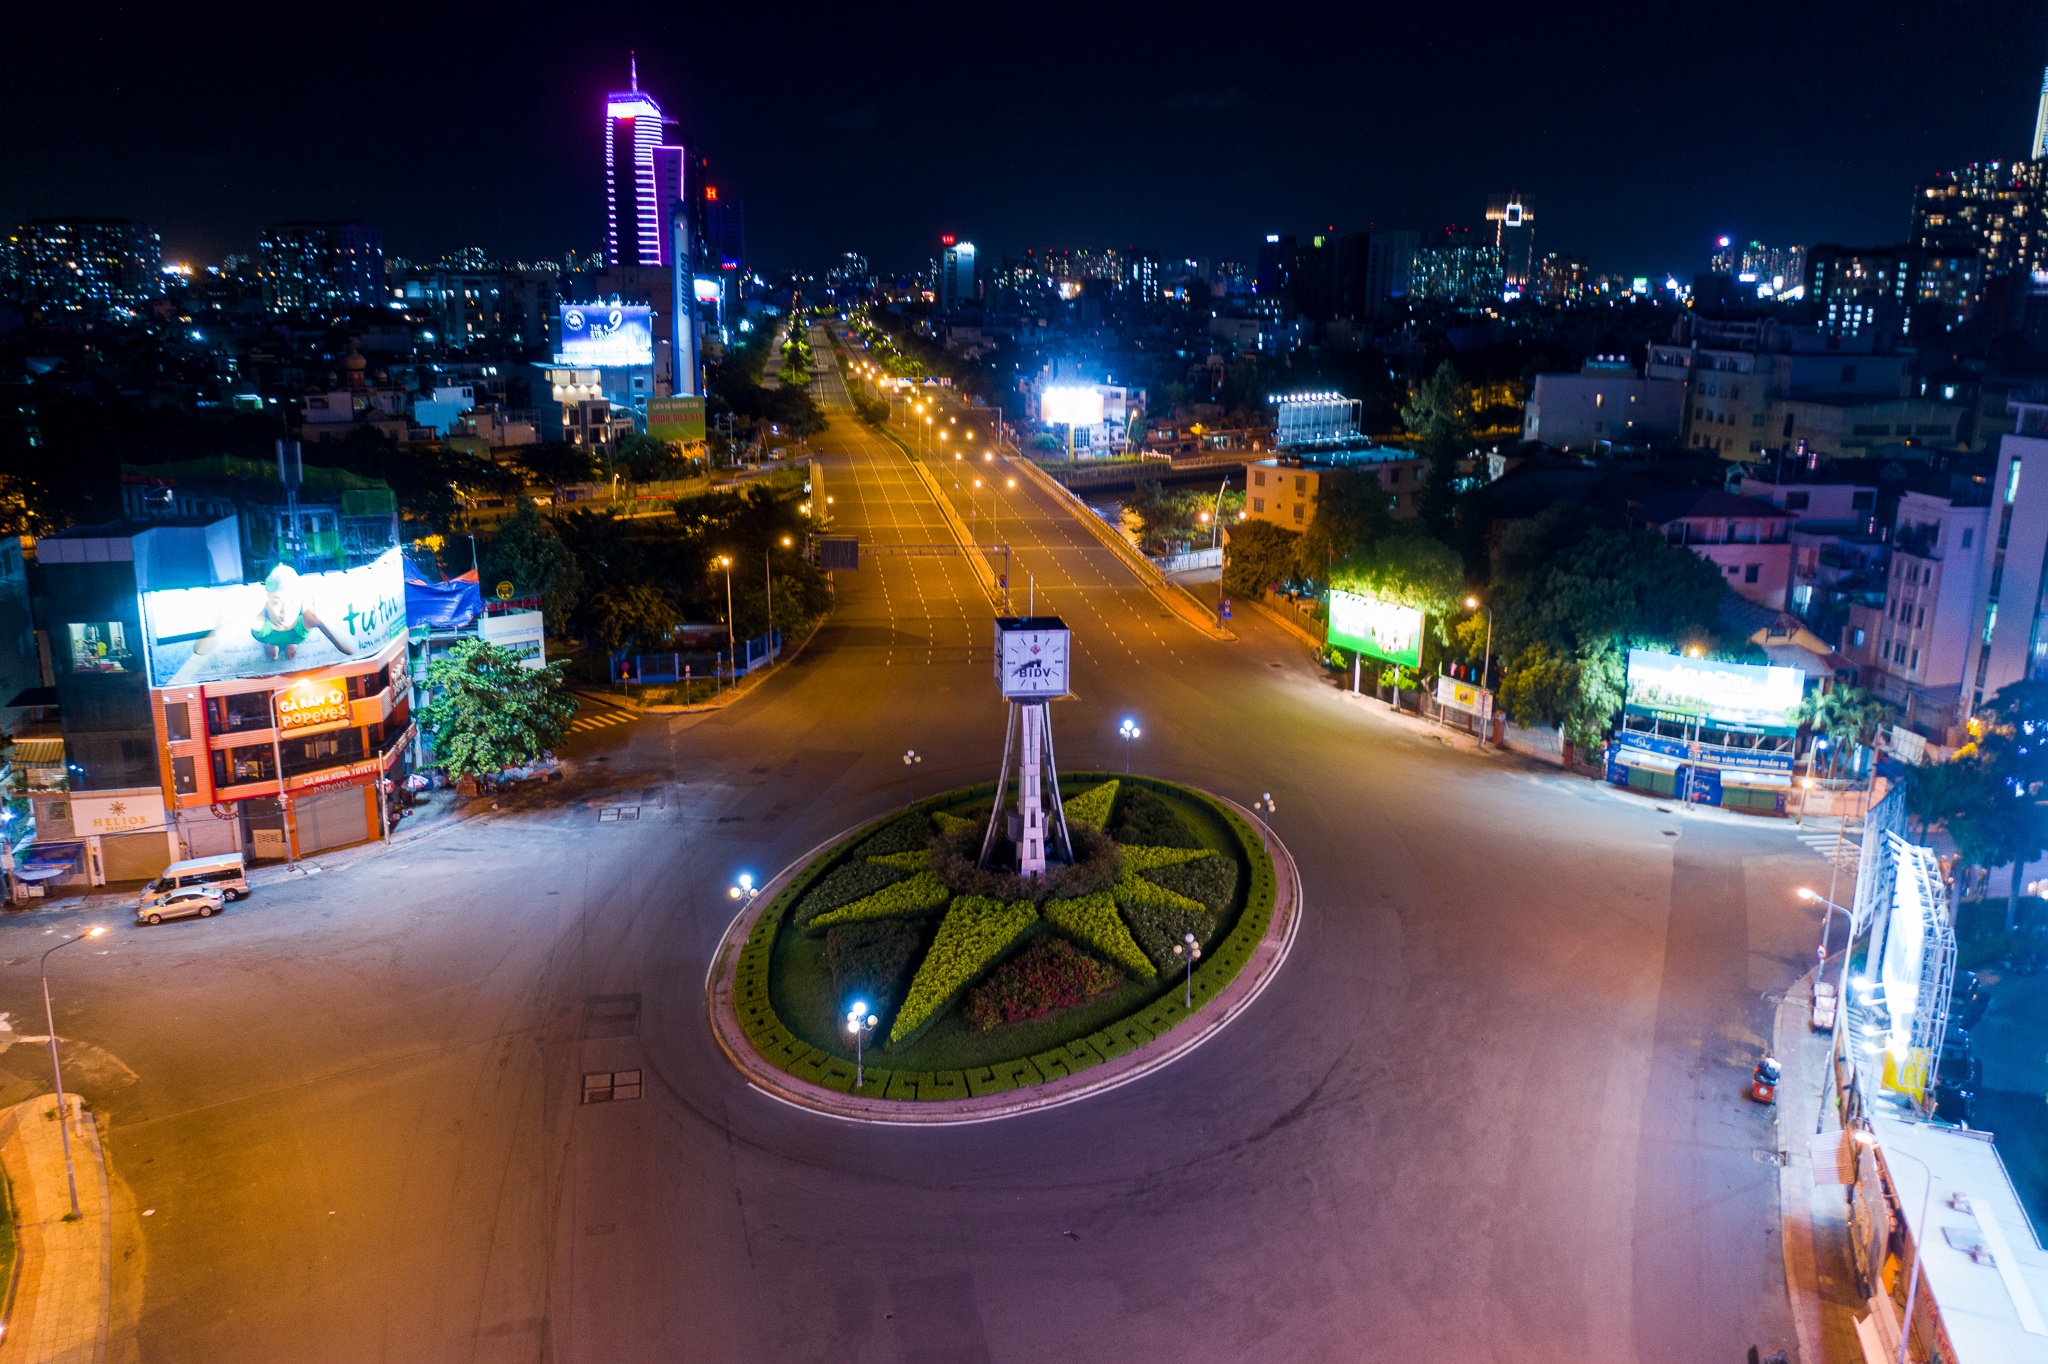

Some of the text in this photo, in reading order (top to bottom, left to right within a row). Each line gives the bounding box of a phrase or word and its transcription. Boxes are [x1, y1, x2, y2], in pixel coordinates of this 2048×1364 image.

[706, 187, 717, 200] H
[680, 252, 691, 316] SAWACO
[604, 310, 623, 331] 9
[1020, 668, 1051, 678] BIDV
[280, 693, 325, 712] GÀ RÁN
[93, 816, 146, 827] HELIOS
